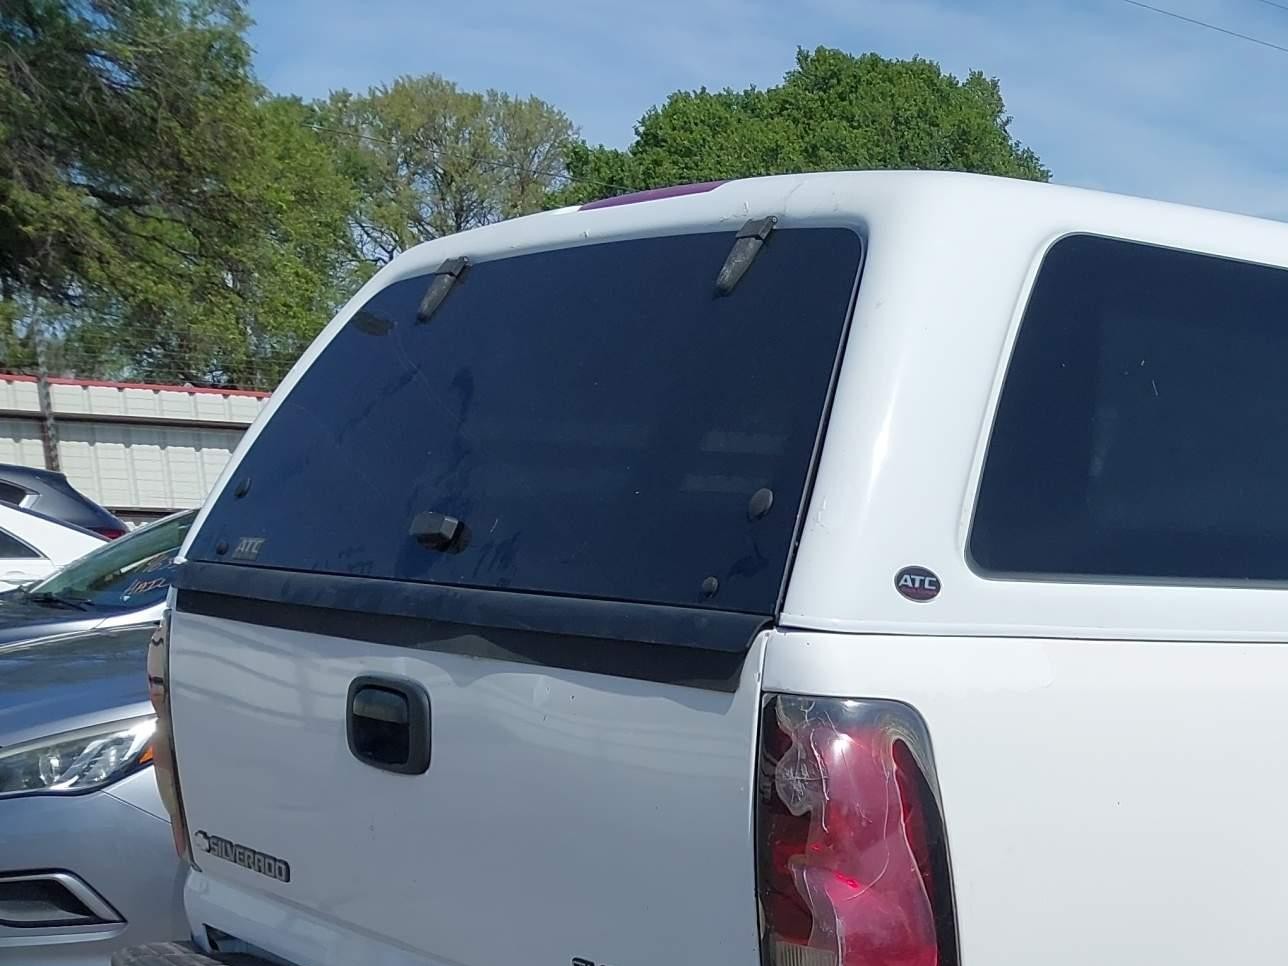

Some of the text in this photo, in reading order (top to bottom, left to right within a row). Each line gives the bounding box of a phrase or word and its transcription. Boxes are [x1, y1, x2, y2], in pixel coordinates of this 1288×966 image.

[234, 536, 265, 553] ATC
[898, 574, 937, 590] ATC
[208, 835, 290, 883] SILVERADO
